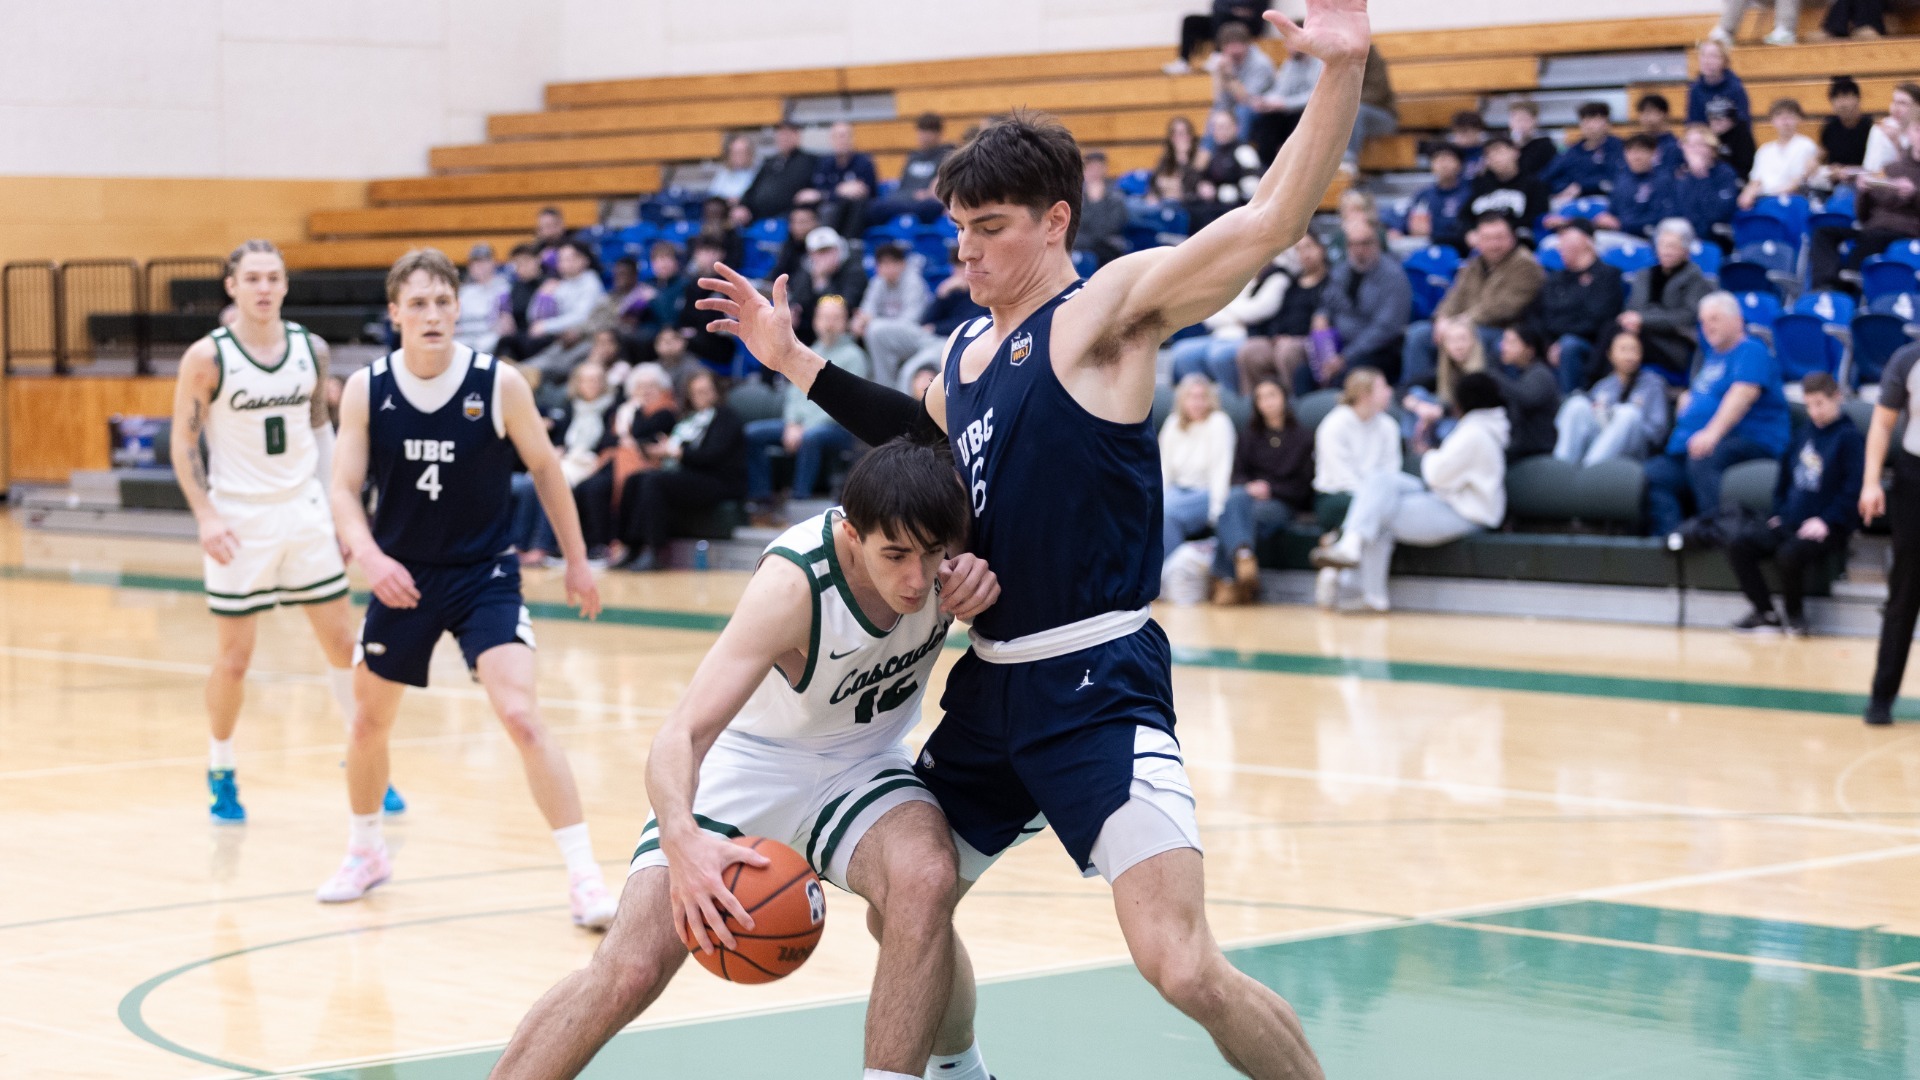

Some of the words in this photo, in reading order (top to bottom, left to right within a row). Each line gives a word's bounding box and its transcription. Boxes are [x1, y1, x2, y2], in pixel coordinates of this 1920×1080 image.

[230, 384, 309, 411] Cascade
[265, 416, 286, 455] 0
[403, 439, 455, 462] UBC
[957, 407, 993, 467] UBC
[415, 463, 443, 501] 4
[972, 456, 987, 518] 6
